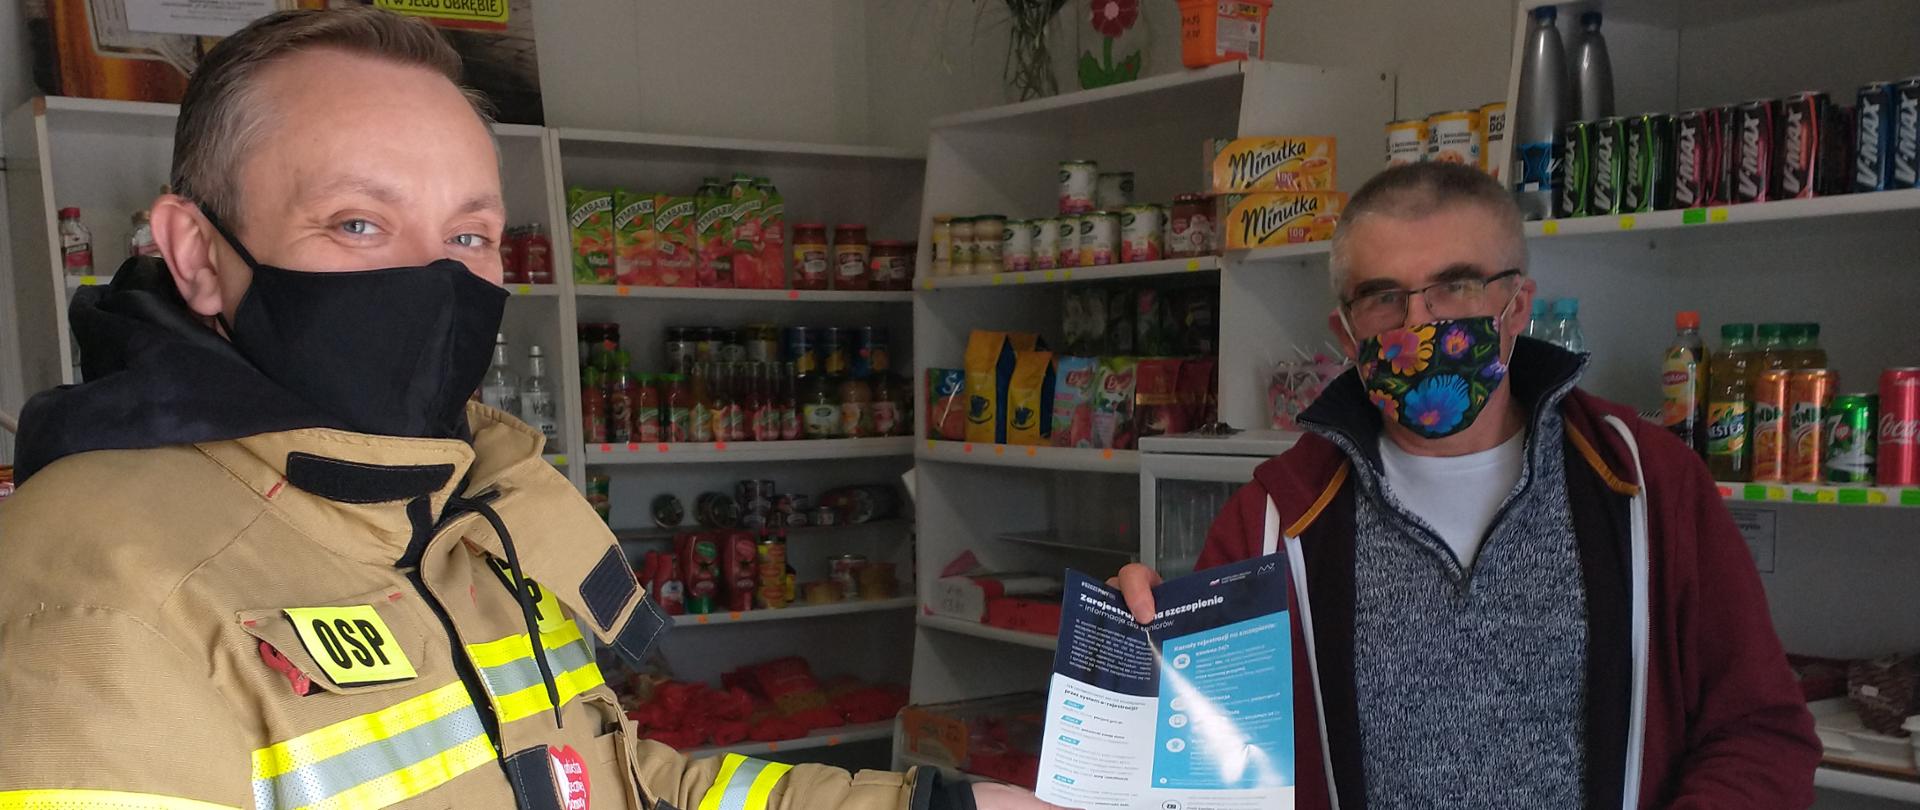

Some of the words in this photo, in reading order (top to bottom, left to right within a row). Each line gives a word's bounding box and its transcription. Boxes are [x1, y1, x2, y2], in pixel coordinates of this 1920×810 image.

[443, 0, 498, 15] OBRĘBIE
[1228, 139, 1306, 188] Minutka
[572, 197, 612, 224] TYMBARK
[616, 200, 654, 227] TYMBARK
[656, 203, 694, 229] TYMBARK
[1241, 195, 1318, 245] Minutka
[1080, 593, 1136, 621] Zarejestruj
[1165, 595, 1224, 616] szczepienie
[1084, 605, 1126, 625] informacja
[312, 619, 391, 669] OSP
